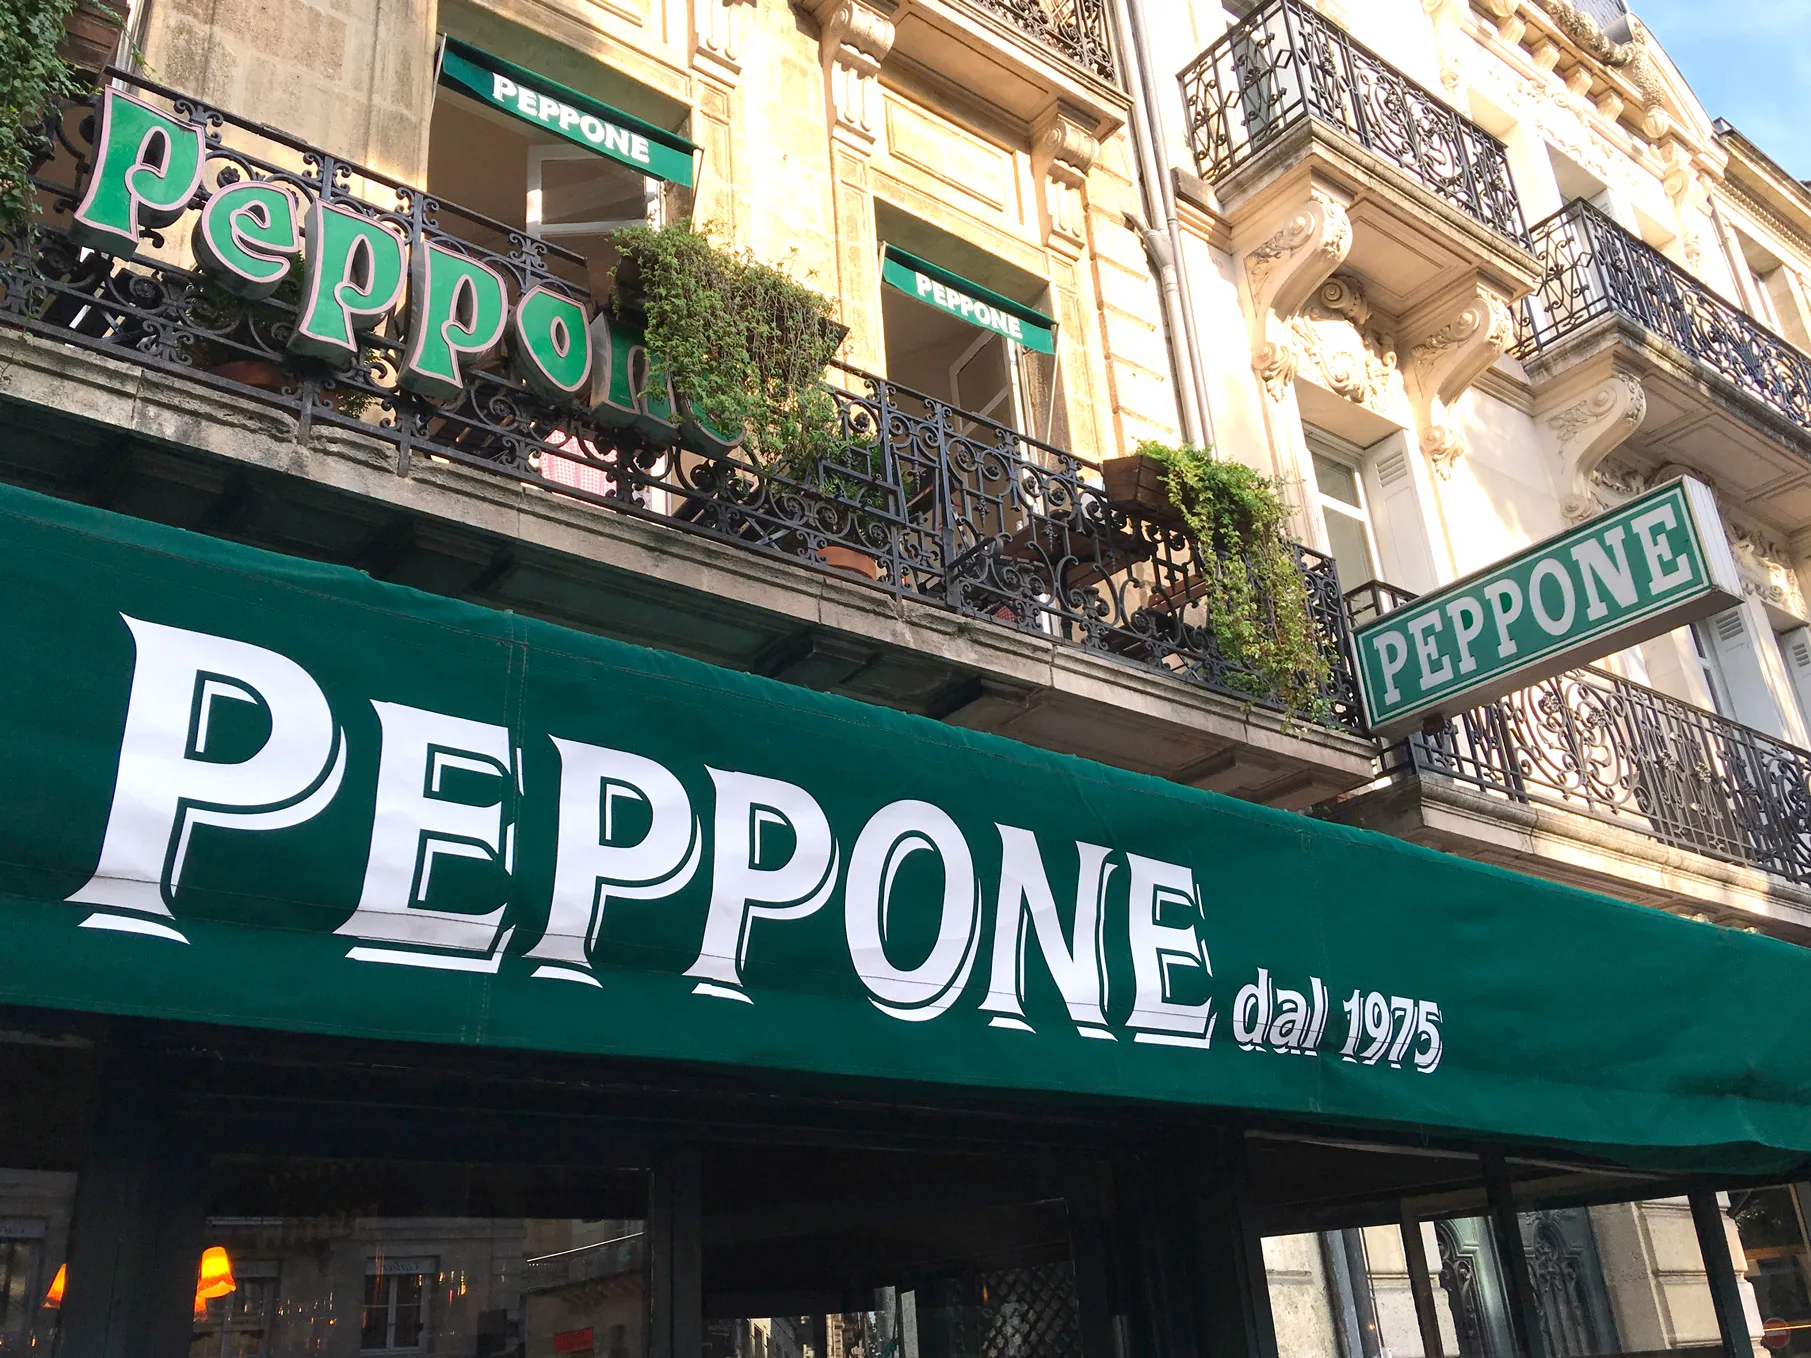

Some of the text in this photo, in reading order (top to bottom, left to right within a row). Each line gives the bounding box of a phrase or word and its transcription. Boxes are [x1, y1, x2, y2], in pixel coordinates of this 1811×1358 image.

[492, 73, 650, 164] PEPPONE
[915, 272, 1023, 340] PEPPONE
[1373, 503, 1693, 706] PEPPONE
[63, 611, 1443, 1074] PEPPONE dal 1975
